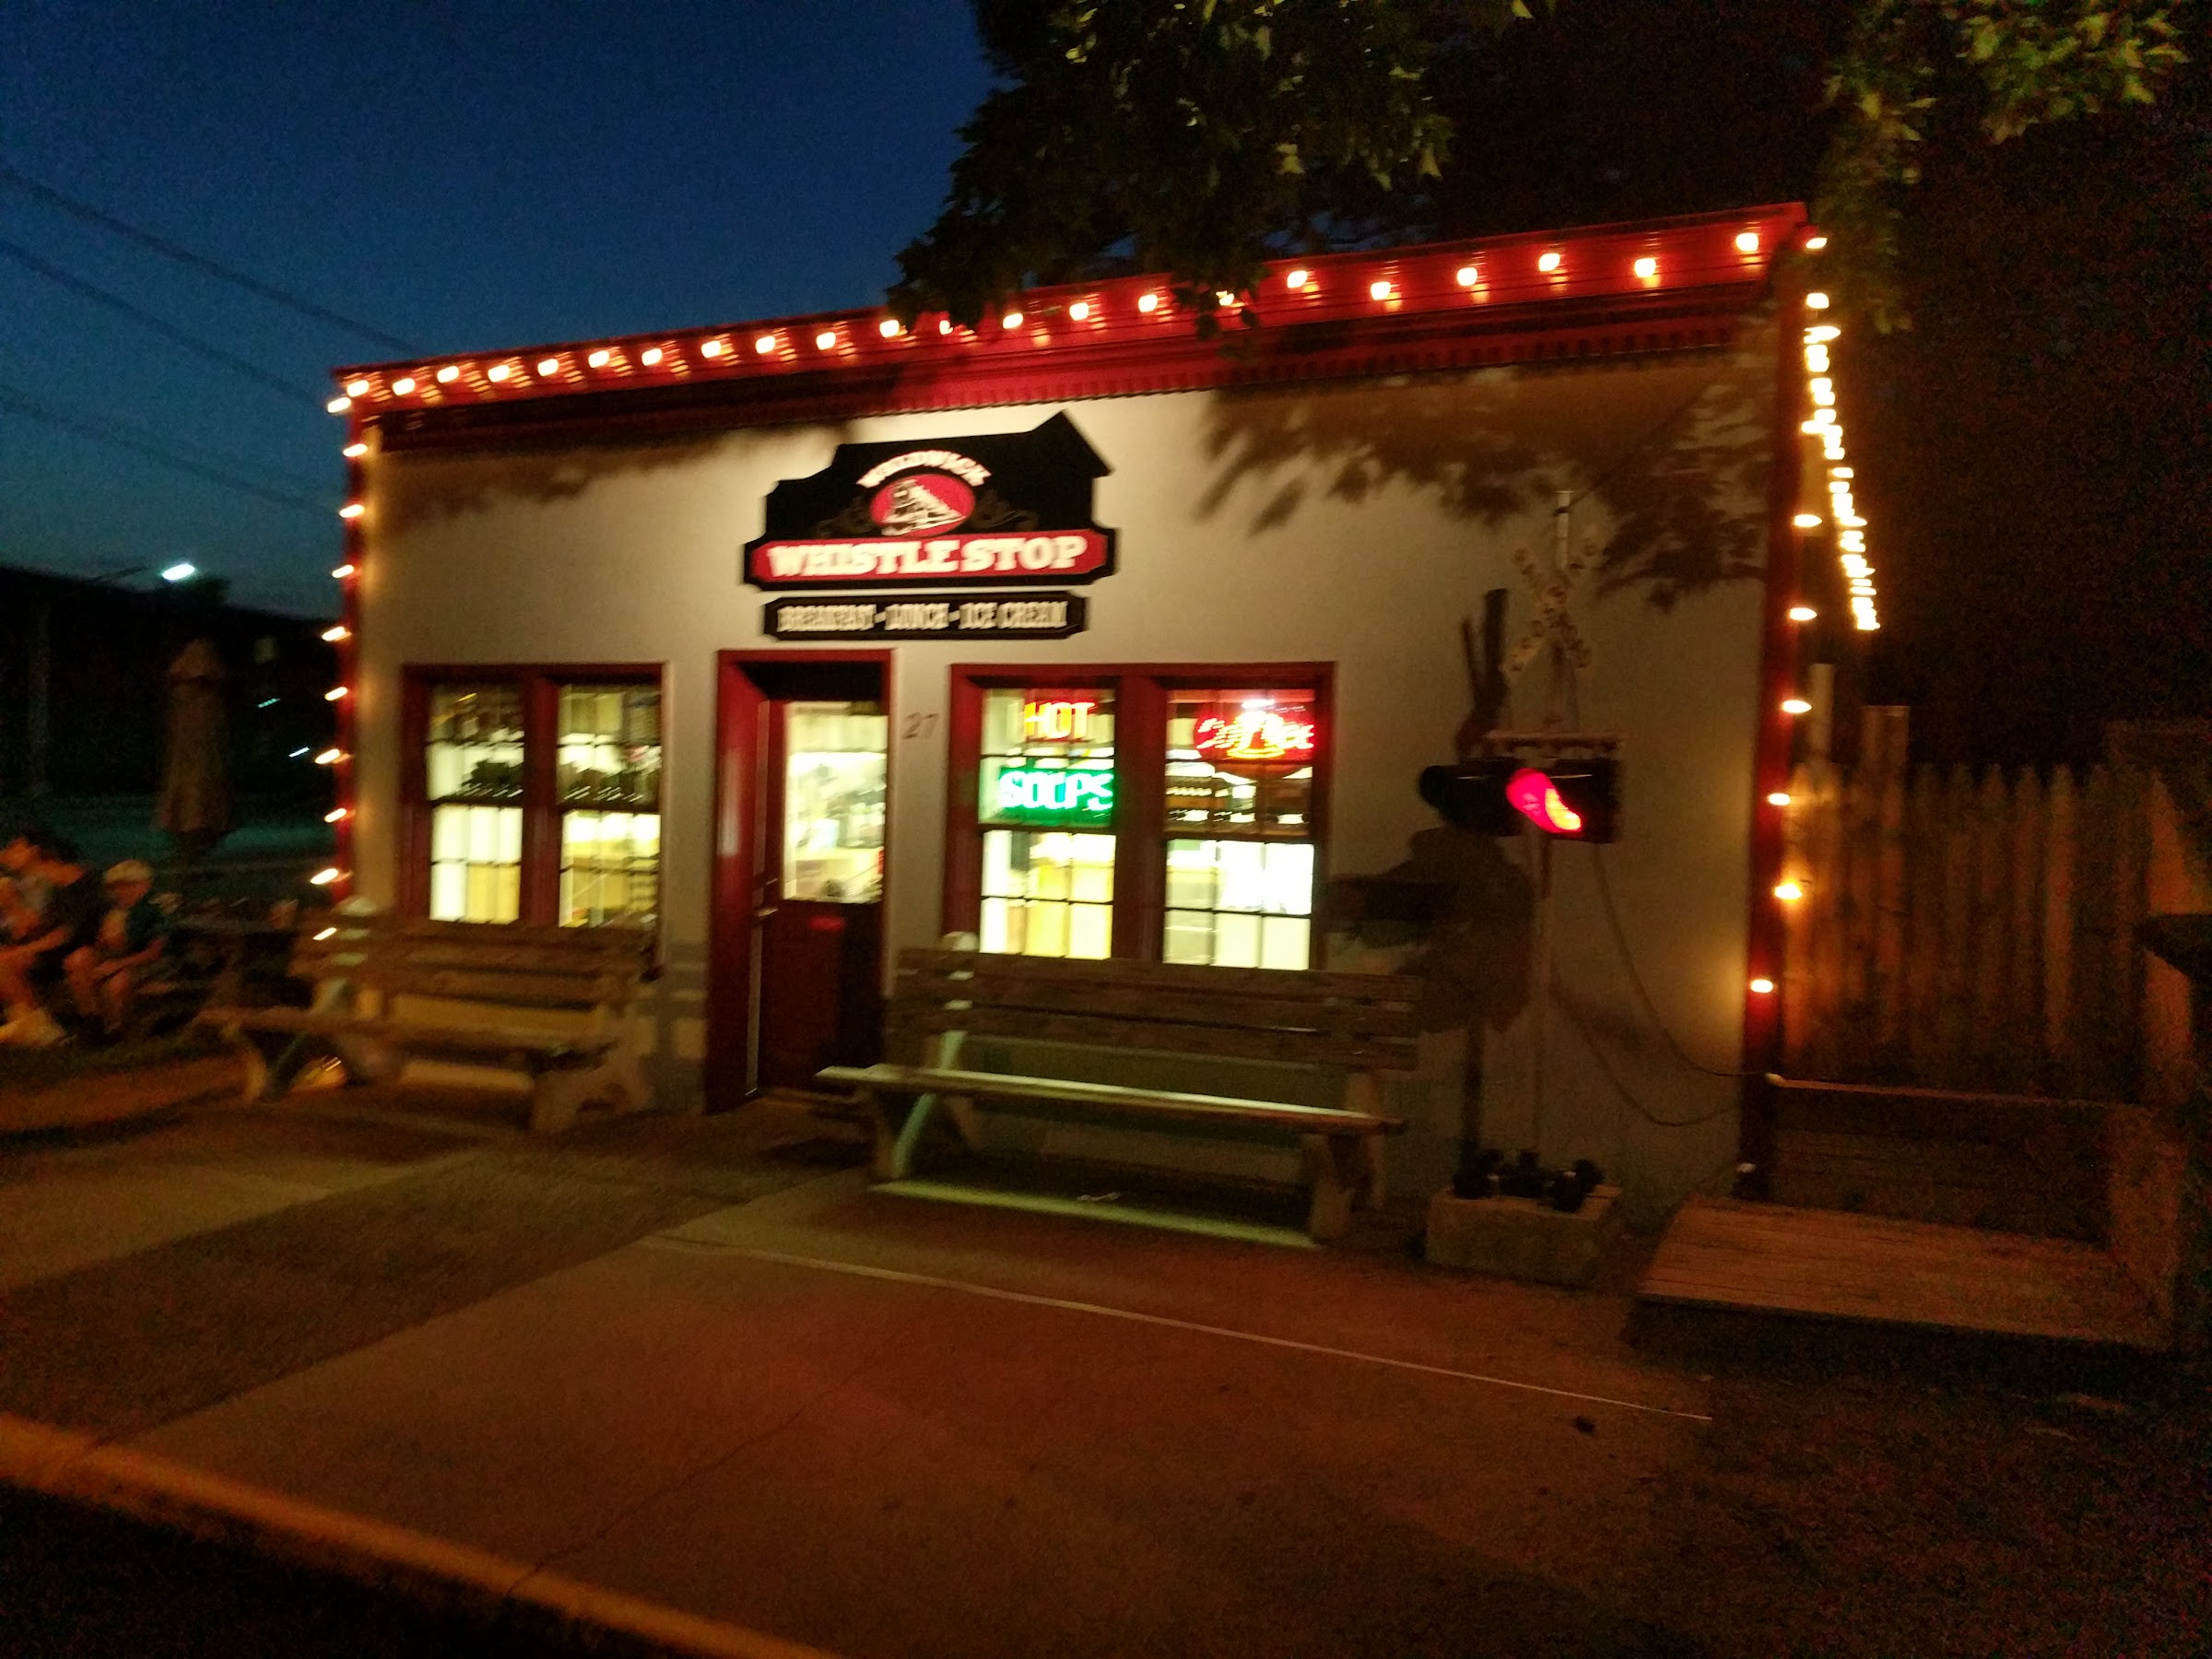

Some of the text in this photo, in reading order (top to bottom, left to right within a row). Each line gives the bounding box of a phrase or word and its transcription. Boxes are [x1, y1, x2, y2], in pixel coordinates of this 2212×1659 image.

[768, 535, 1088, 577] WHISTLE STOP
[884, 603, 949, 630] LUNCH
[959, 602, 998, 629] ICE
[998, 601, 1067, 629] CREAM
[900, 712, 940, 740] 27
[1024, 701, 1095, 739] HOT
[998, 771, 1113, 811] SOUPS
